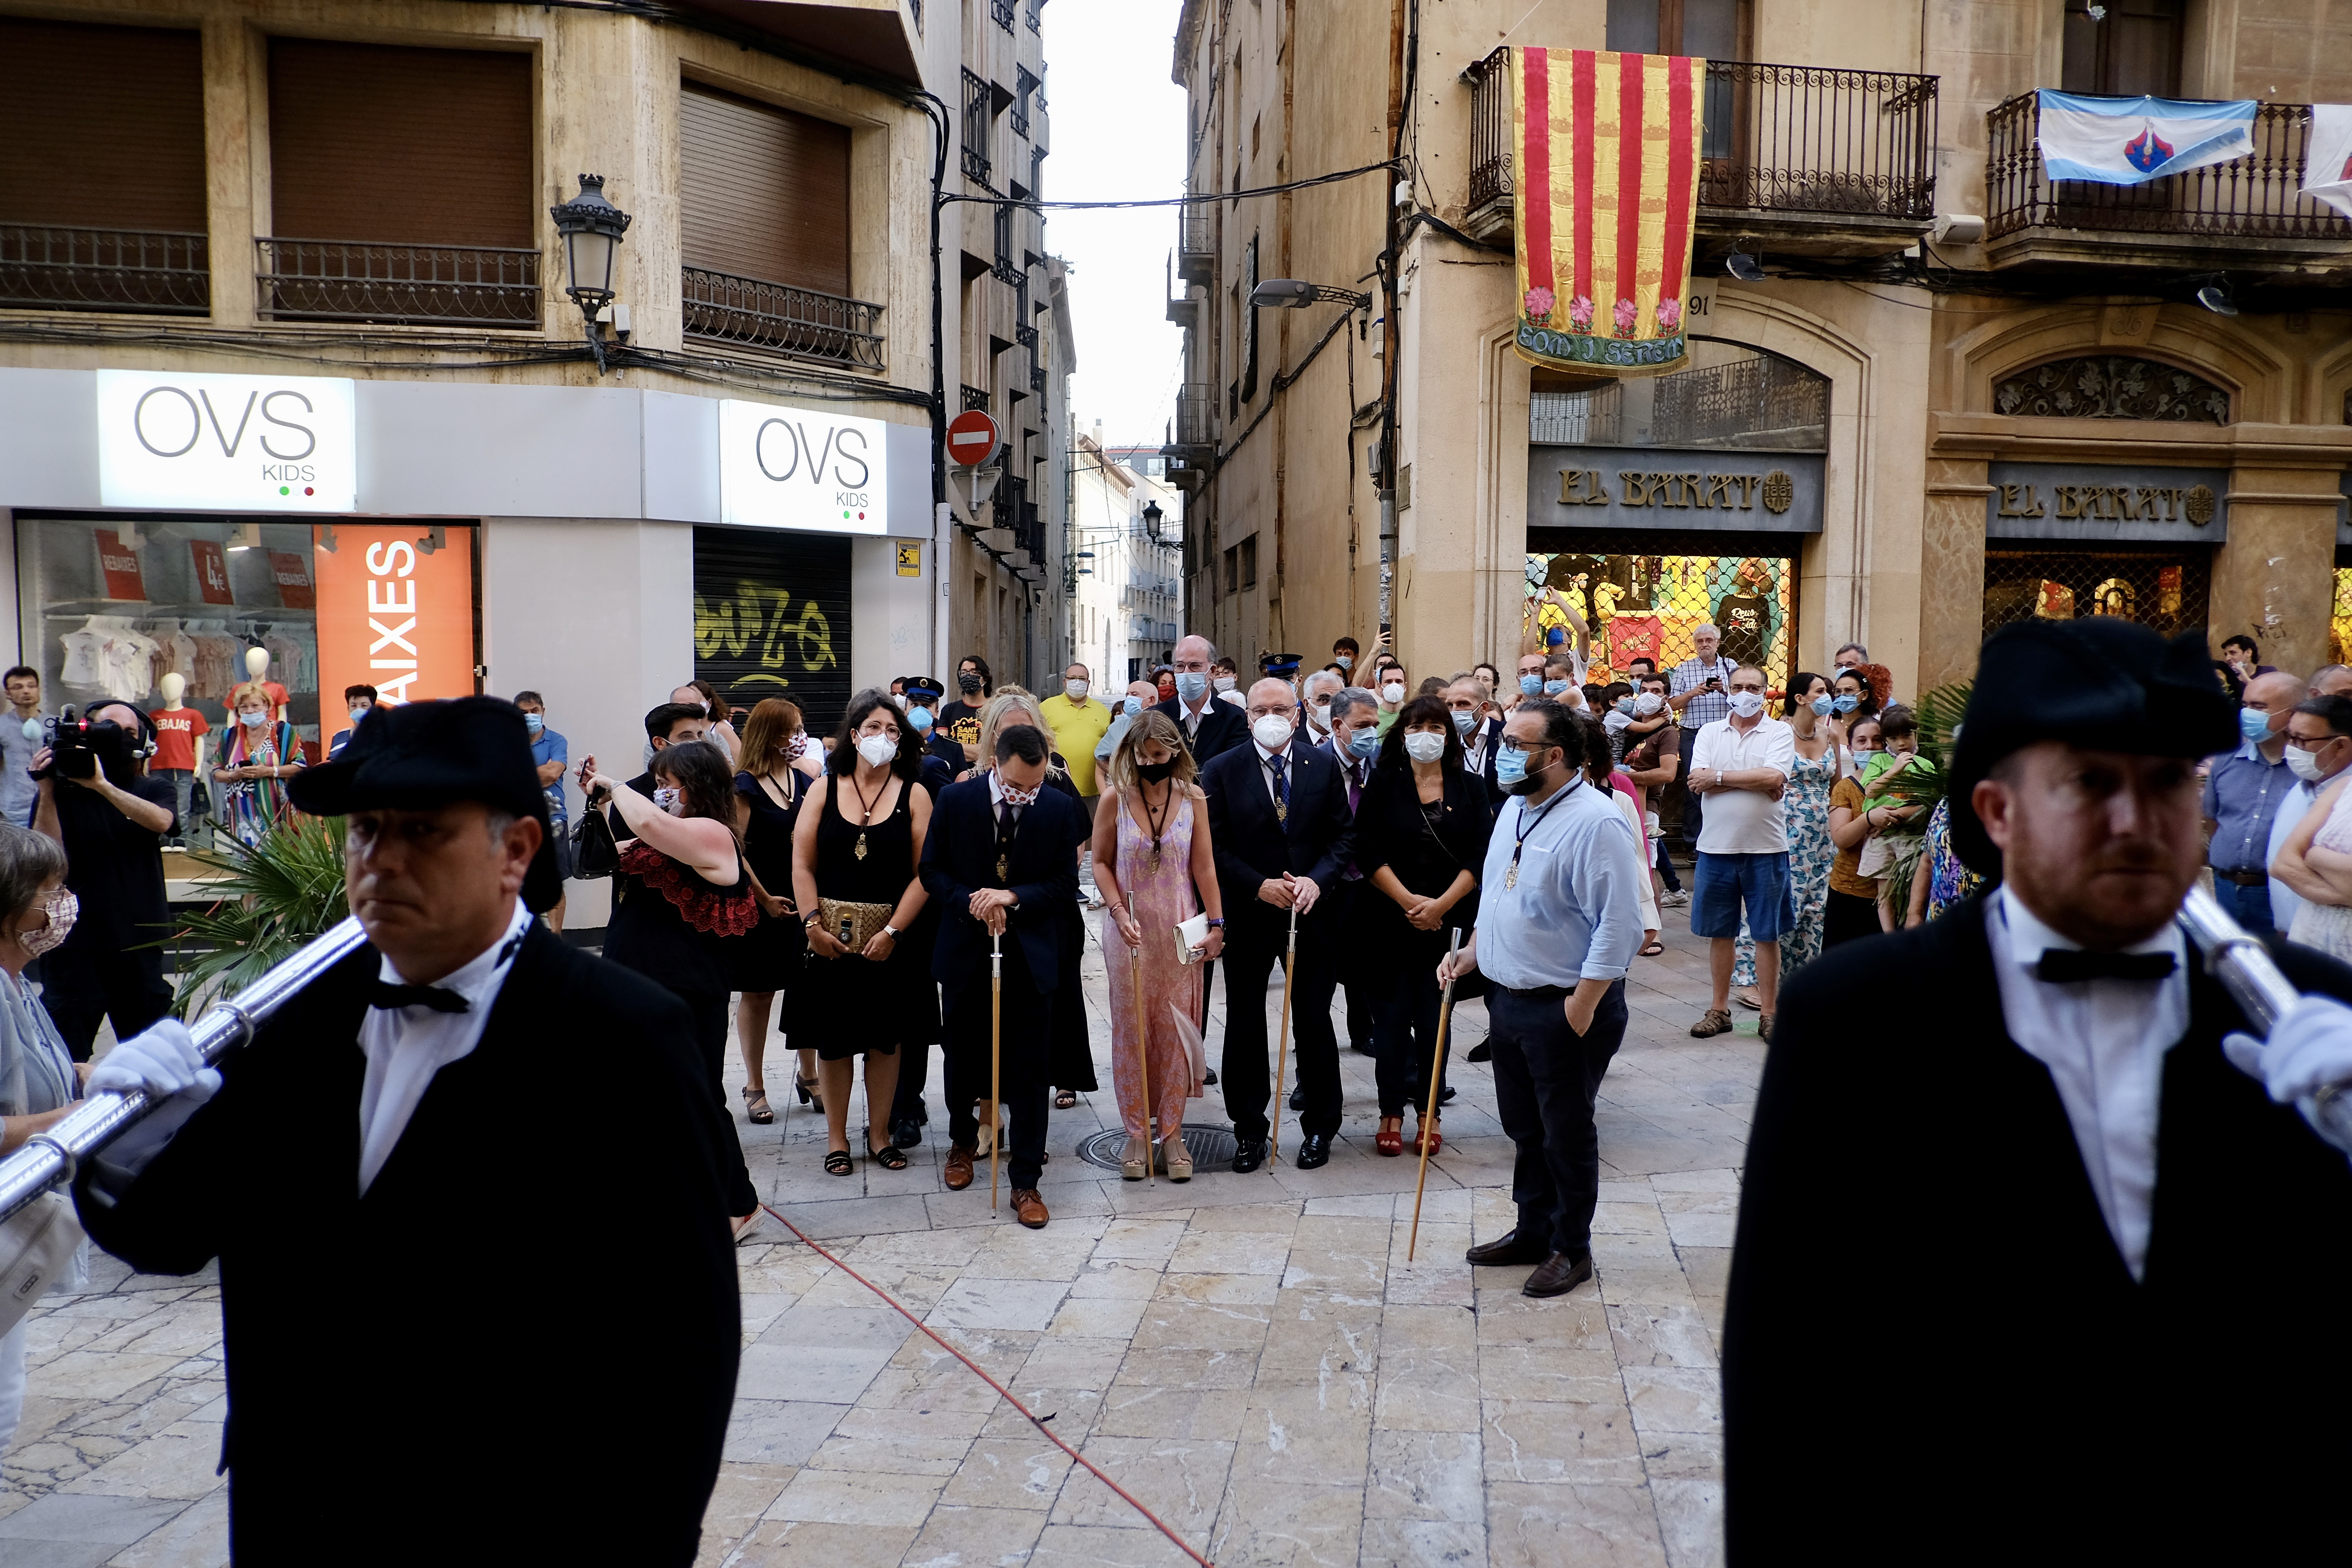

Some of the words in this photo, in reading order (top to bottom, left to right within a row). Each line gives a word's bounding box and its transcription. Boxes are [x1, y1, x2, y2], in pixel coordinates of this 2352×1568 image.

[1690, 296, 1709, 316] 91
[1517, 326, 1571, 357] SOM
[134, 386, 316, 461] OVS
[756, 418, 869, 490] OVS
[262, 465, 315, 482] KIDS
[1557, 470, 1610, 504] EL
[836, 491, 869, 508] KIDS
[1764, 486, 1792, 497] 1881
[1997, 485, 2045, 517] EL
[366, 540, 417, 706] AIXES
[157, 718, 191, 731] EBAJAS
